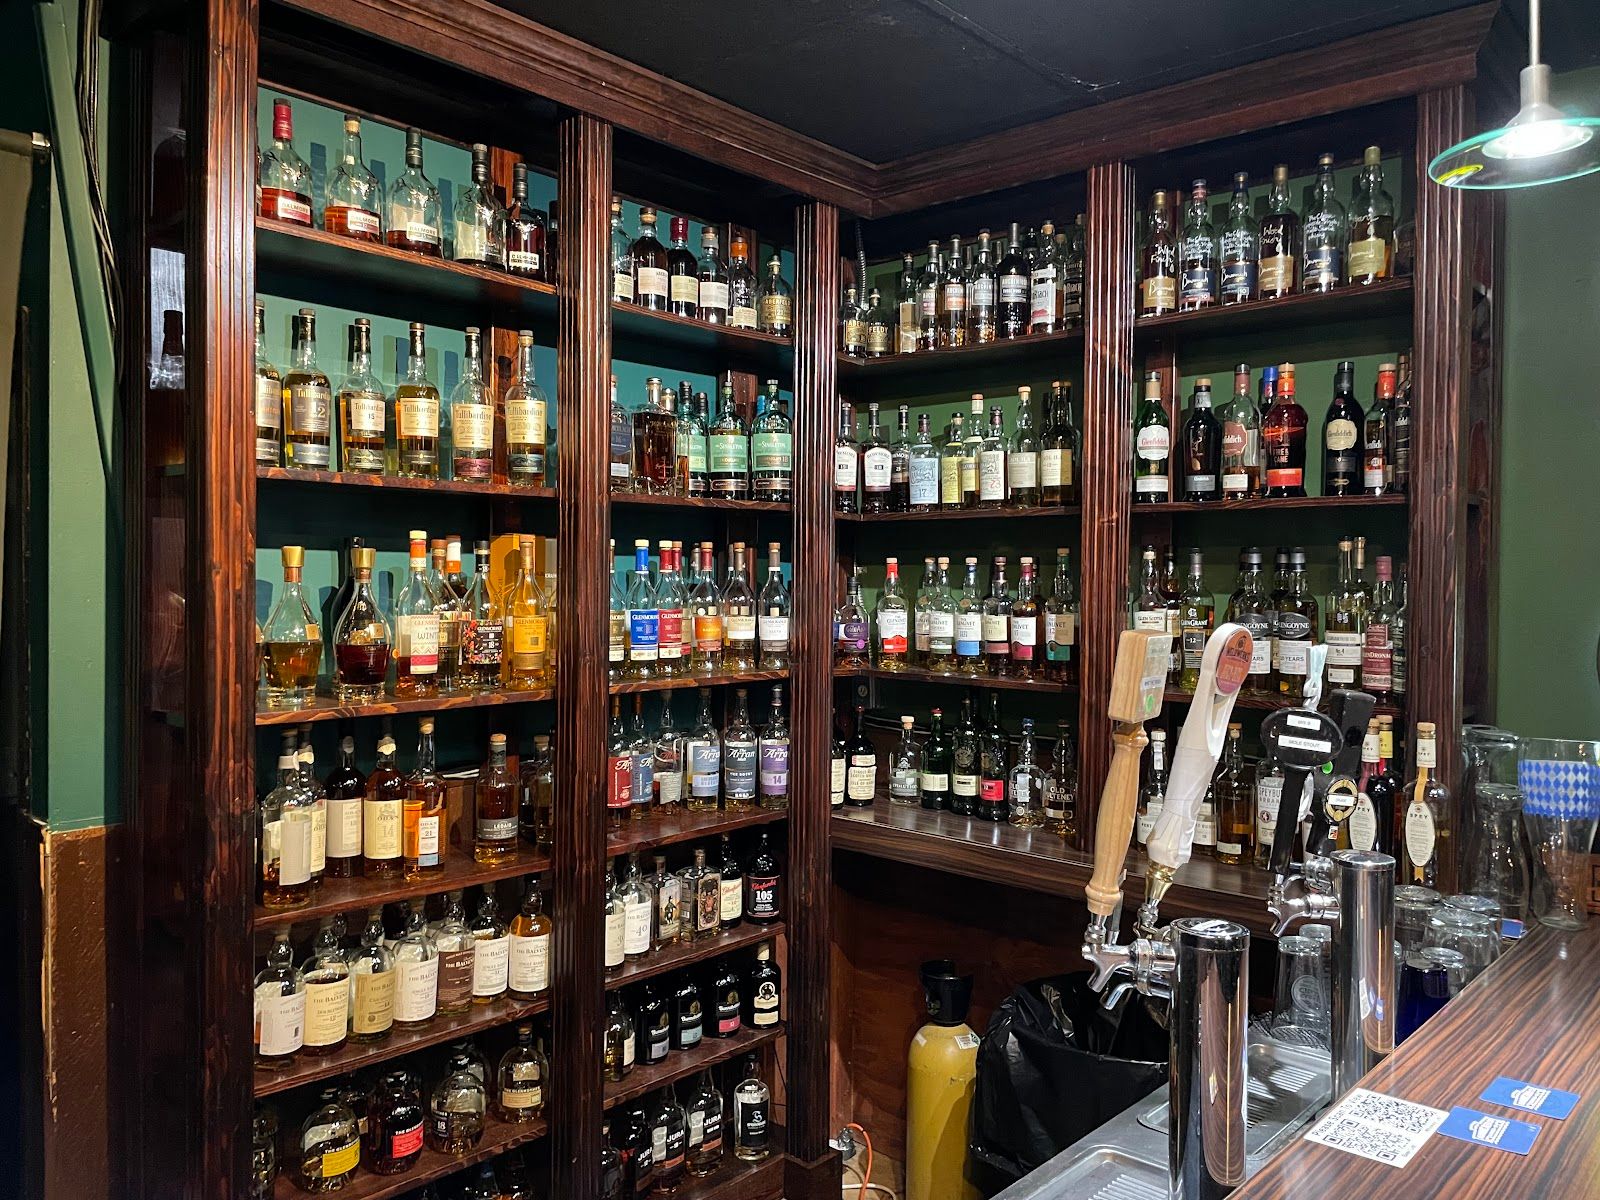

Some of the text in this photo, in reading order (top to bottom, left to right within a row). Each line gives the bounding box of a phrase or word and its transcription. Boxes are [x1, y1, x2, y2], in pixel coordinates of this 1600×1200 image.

[456, 409, 492, 421] Tullibardine
[507, 406, 543, 417] Tullibardine
[1274, 455, 1289, 463] CANE
[728, 748, 755, 758] Arran
[763, 748, 788, 758] Arra
[773, 775, 782, 784] 14
[1258, 787, 1281, 797] SPEYBU
[756, 890, 773, 900] 105
[704, 1114, 721, 1126] JURA
[438, 1121, 446, 1130] 18
[1311, 1120, 1335, 1136] Please
[667, 1129, 684, 1143] JURA
